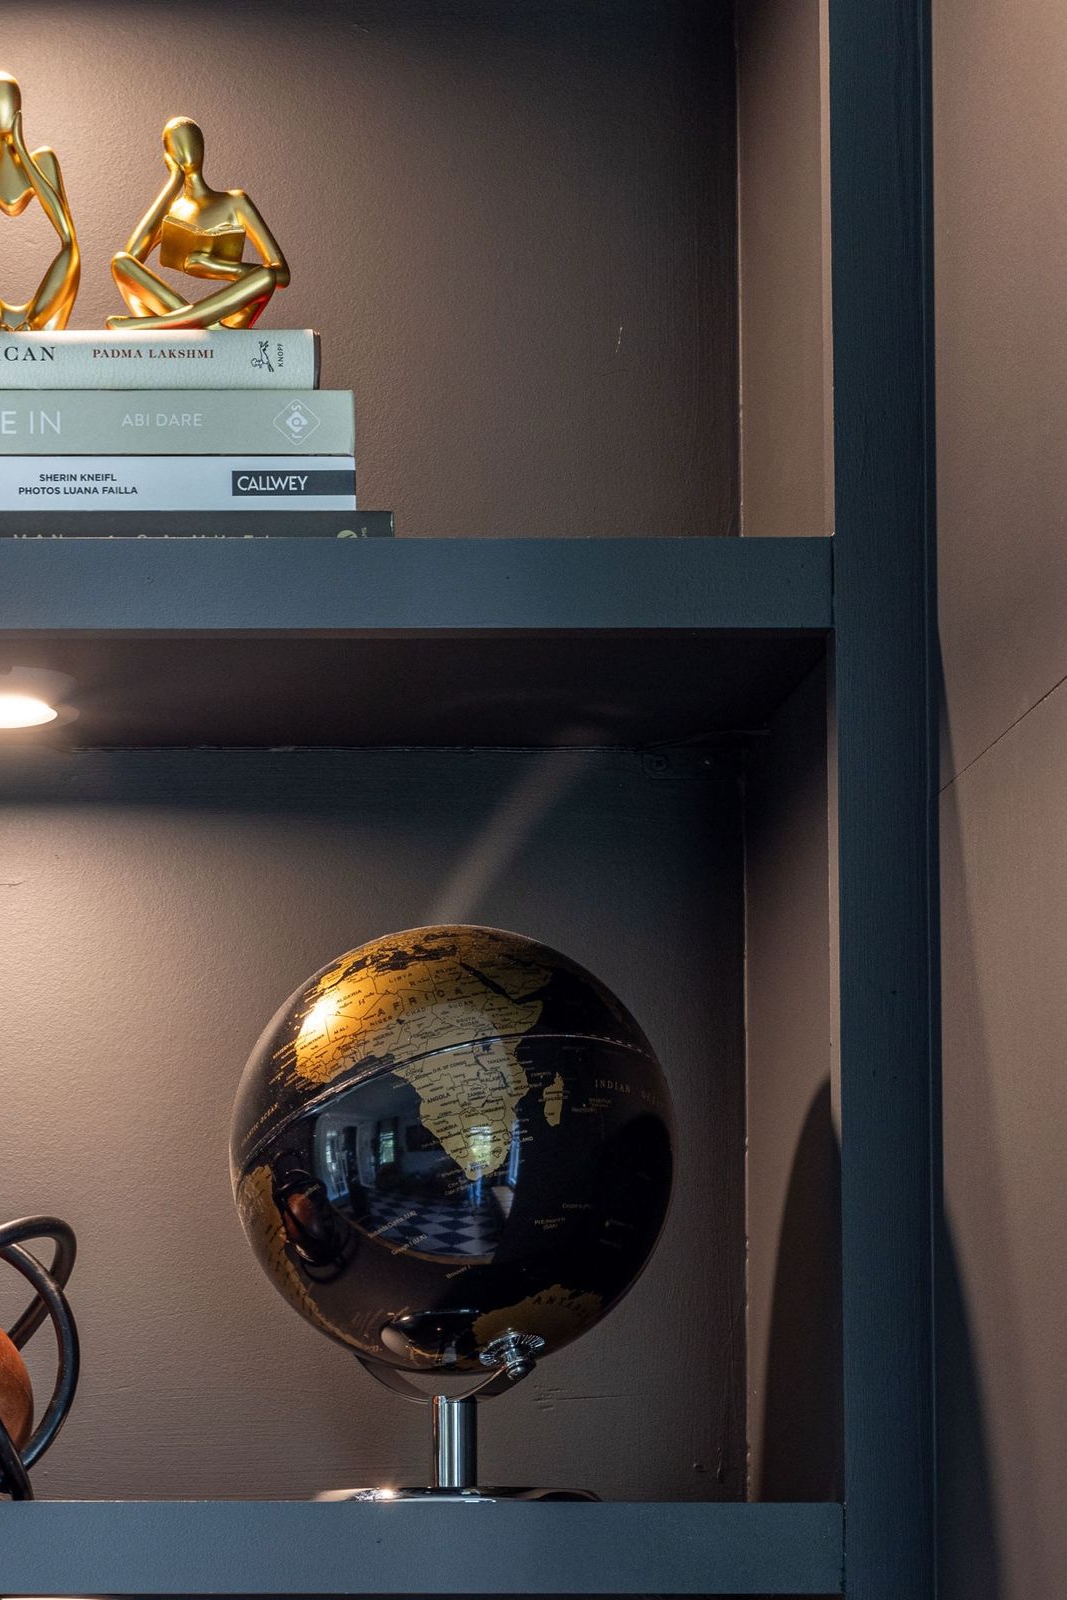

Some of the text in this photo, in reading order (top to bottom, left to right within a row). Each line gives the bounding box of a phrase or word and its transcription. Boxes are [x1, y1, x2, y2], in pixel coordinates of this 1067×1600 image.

[92, 349, 214, 359] PADMA LAKSHMI
[276, 342, 284, 368] KNOPF
[29, 410, 61, 435] IN
[121, 413, 203, 427] ABI DARE
[39, 474, 117, 482] SHERIN KNEIFL
[237, 475, 309, 491] CALLWEY
[18, 486, 138, 495] PHOTOS LUANA FAILLA
[388, 973, 413, 984] LIBYA
[448, 1000, 474, 1009] SUDAN
[405, 1007, 427, 1017] CHAD
[369, 1015, 393, 1027] NIGER
[333, 1025, 349, 1035] MALI
[594, 1079, 631, 1093] INDIAN
